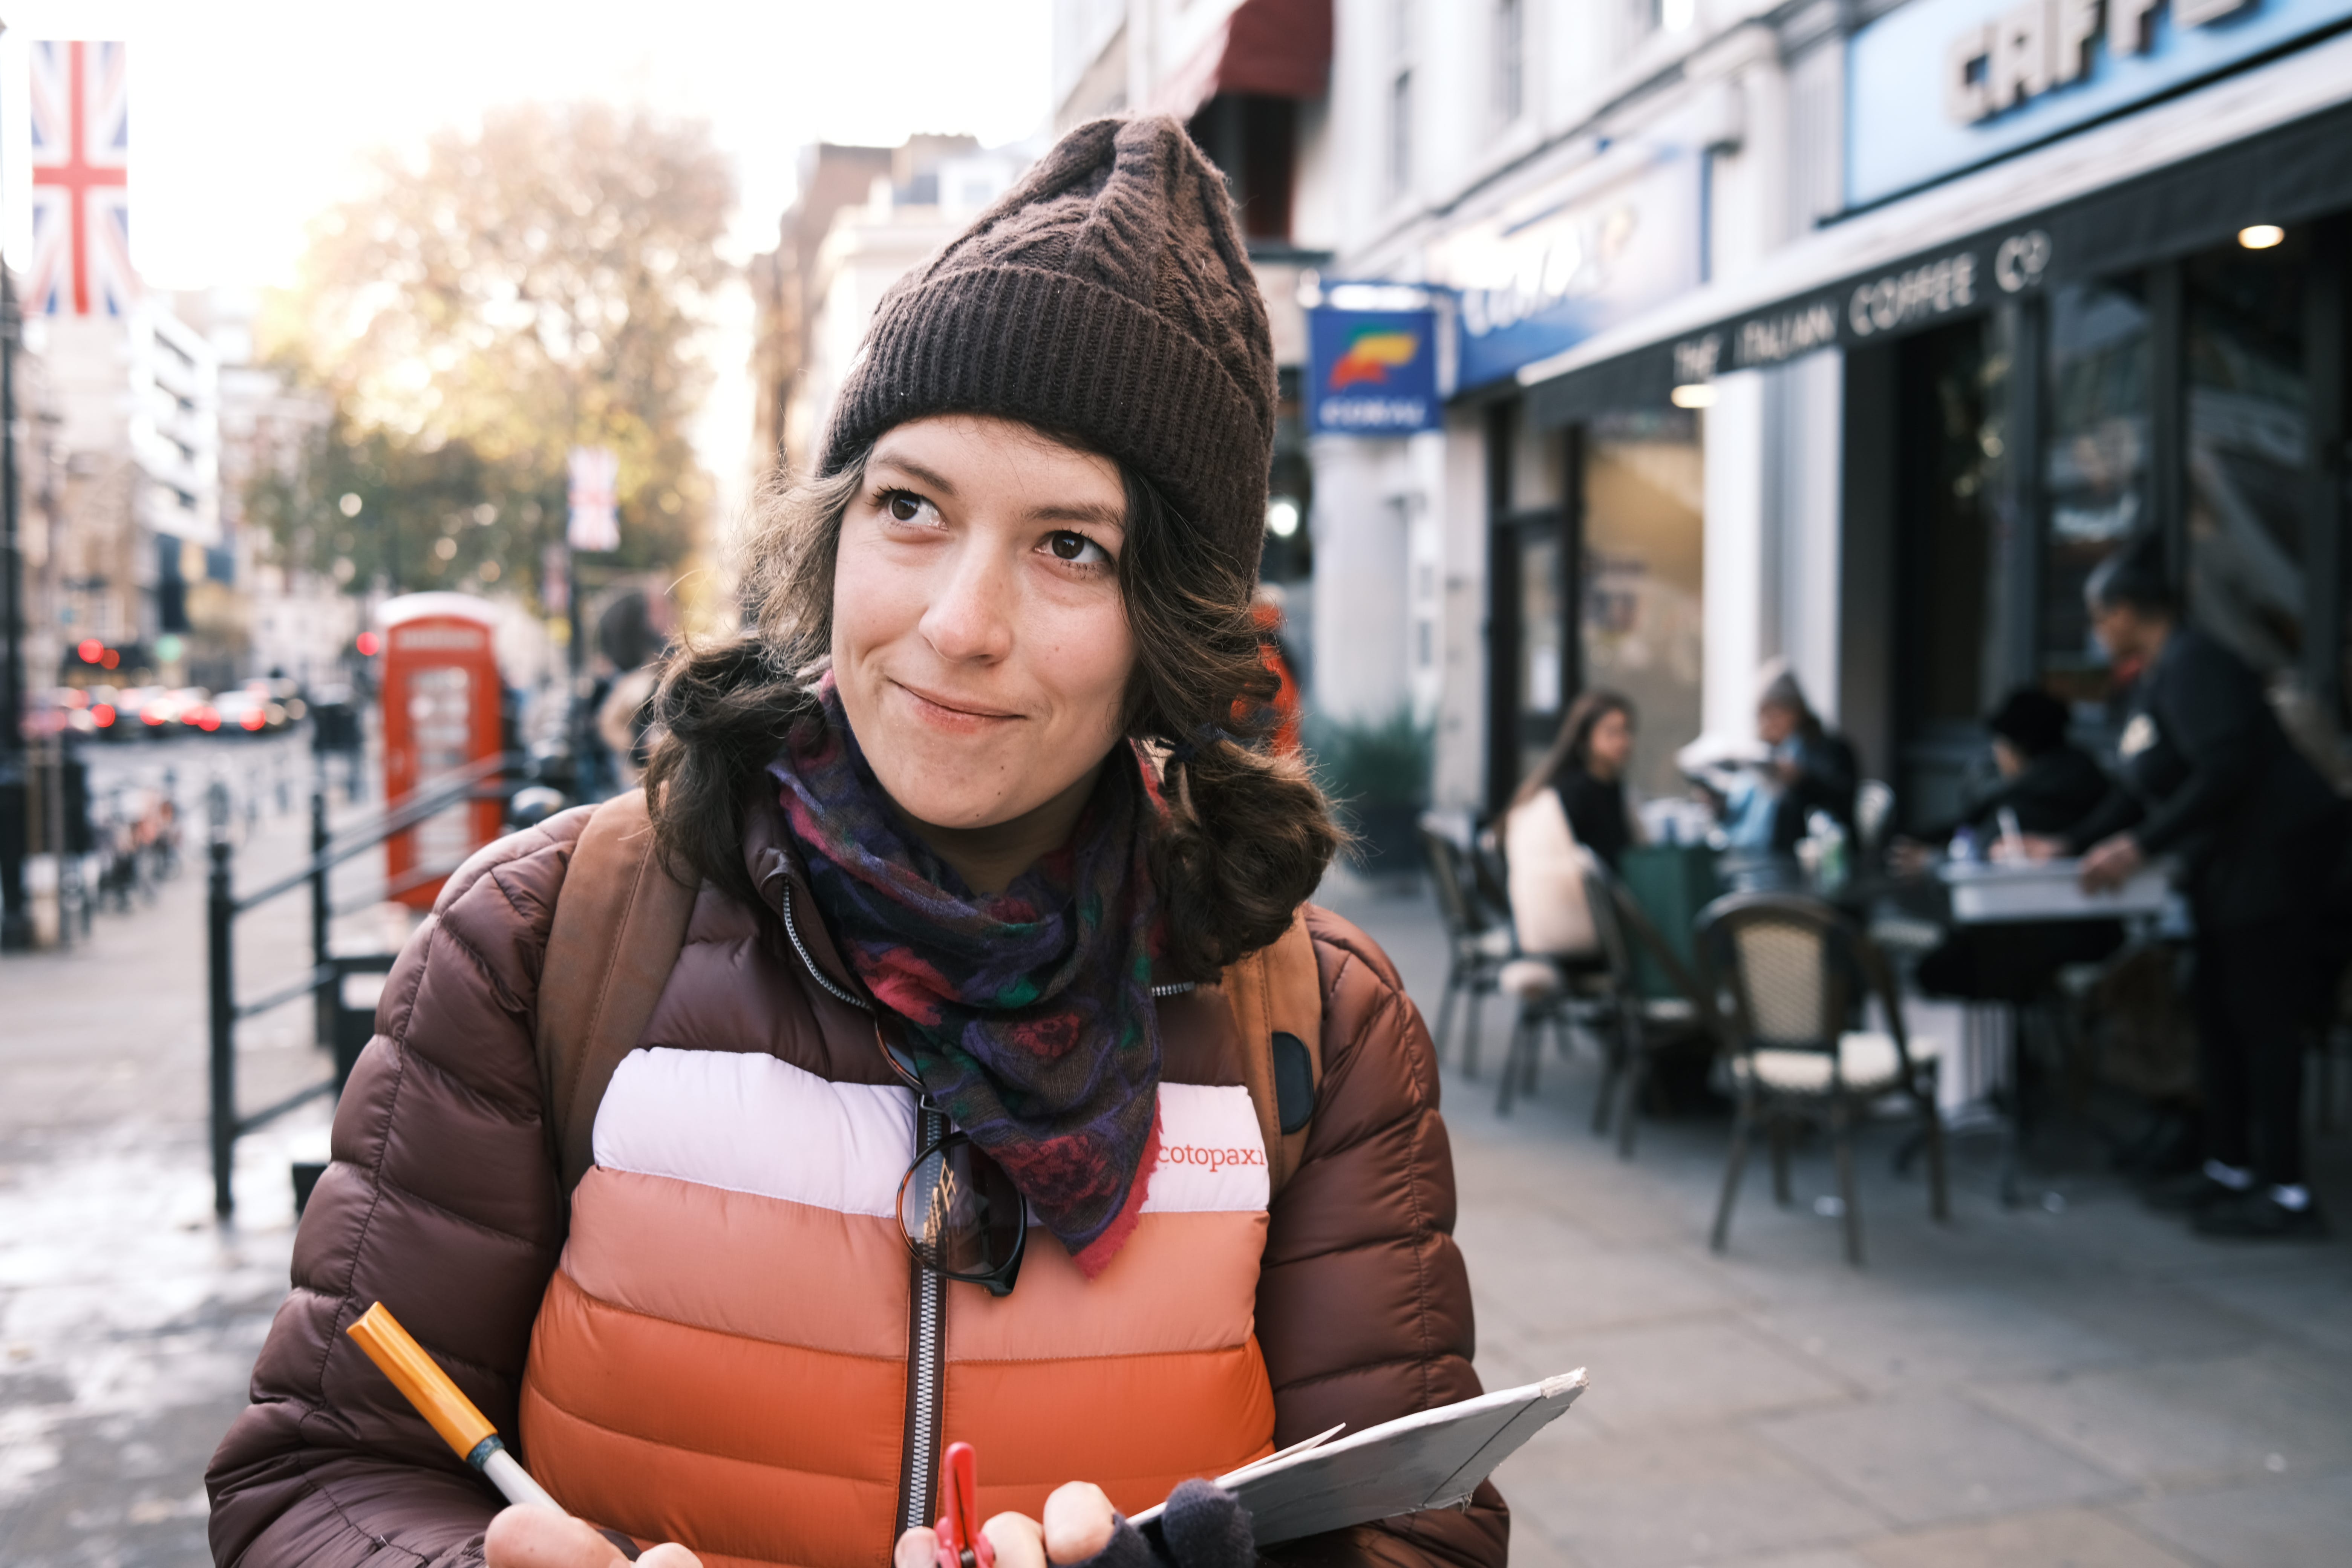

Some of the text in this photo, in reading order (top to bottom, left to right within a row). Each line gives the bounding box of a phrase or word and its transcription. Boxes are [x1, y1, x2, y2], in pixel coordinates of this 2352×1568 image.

[1673, 332, 1721, 381] THE
[1848, 253, 1976, 336] COFFEE
[1158, 1144, 1265, 1172] cotopaxi
